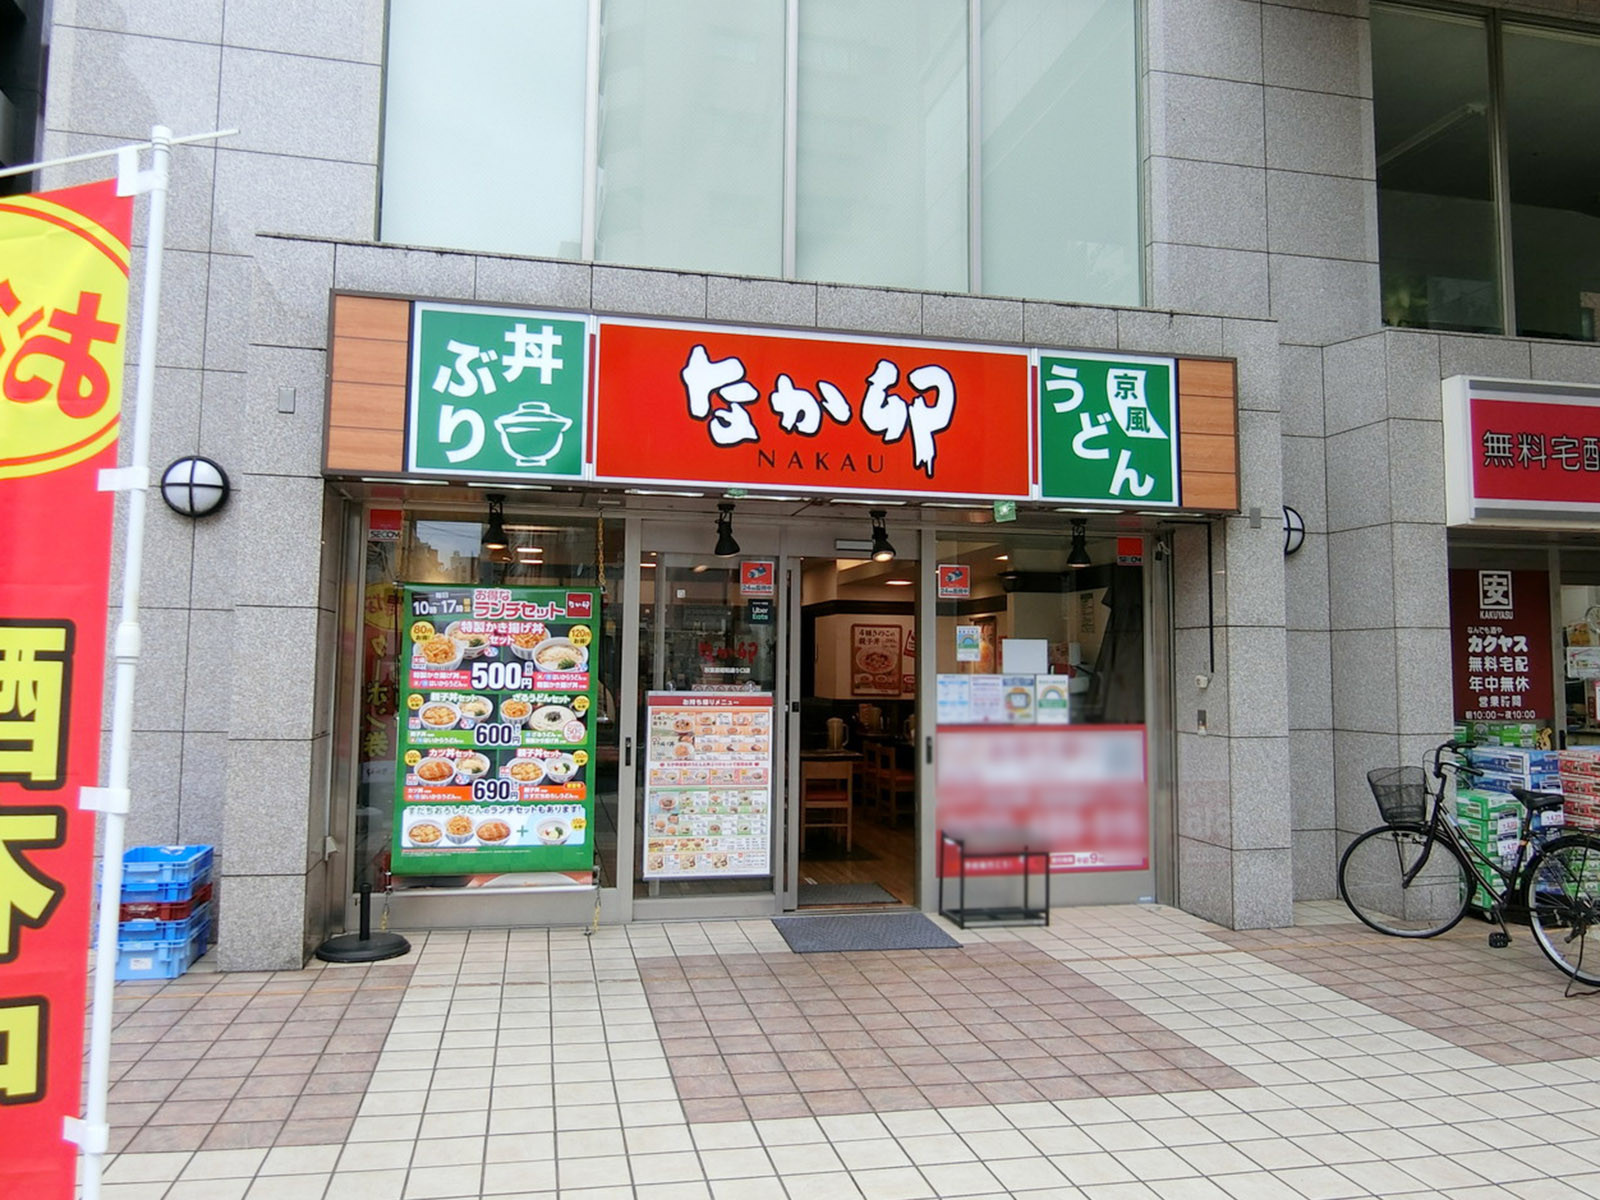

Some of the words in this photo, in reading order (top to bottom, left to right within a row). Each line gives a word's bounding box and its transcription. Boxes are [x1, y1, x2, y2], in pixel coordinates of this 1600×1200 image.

[503, 324, 563, 384] 丼
[681, 344, 955, 478] なか卯
[1114, 374, 1150, 433] 京風
[1045, 364, 1154, 498] うどん
[758, 449, 885, 474] NAKAU
[475, 590, 511, 601] お得な
[1483, 575, 1509, 605] 安
[475, 602, 564, 619] ランチセット
[1480, 610, 1514, 620] KAKUYASU
[460, 621, 544, 634] 特製かき揚げ丼
[489, 635, 515, 646] セット
[1468, 635, 1529, 653] カクヤス
[1468, 656, 1529, 673] 無料宅配
[1469, 676, 1530, 693] 年中無休
[1478, 695, 1523, 708] 営業時間
